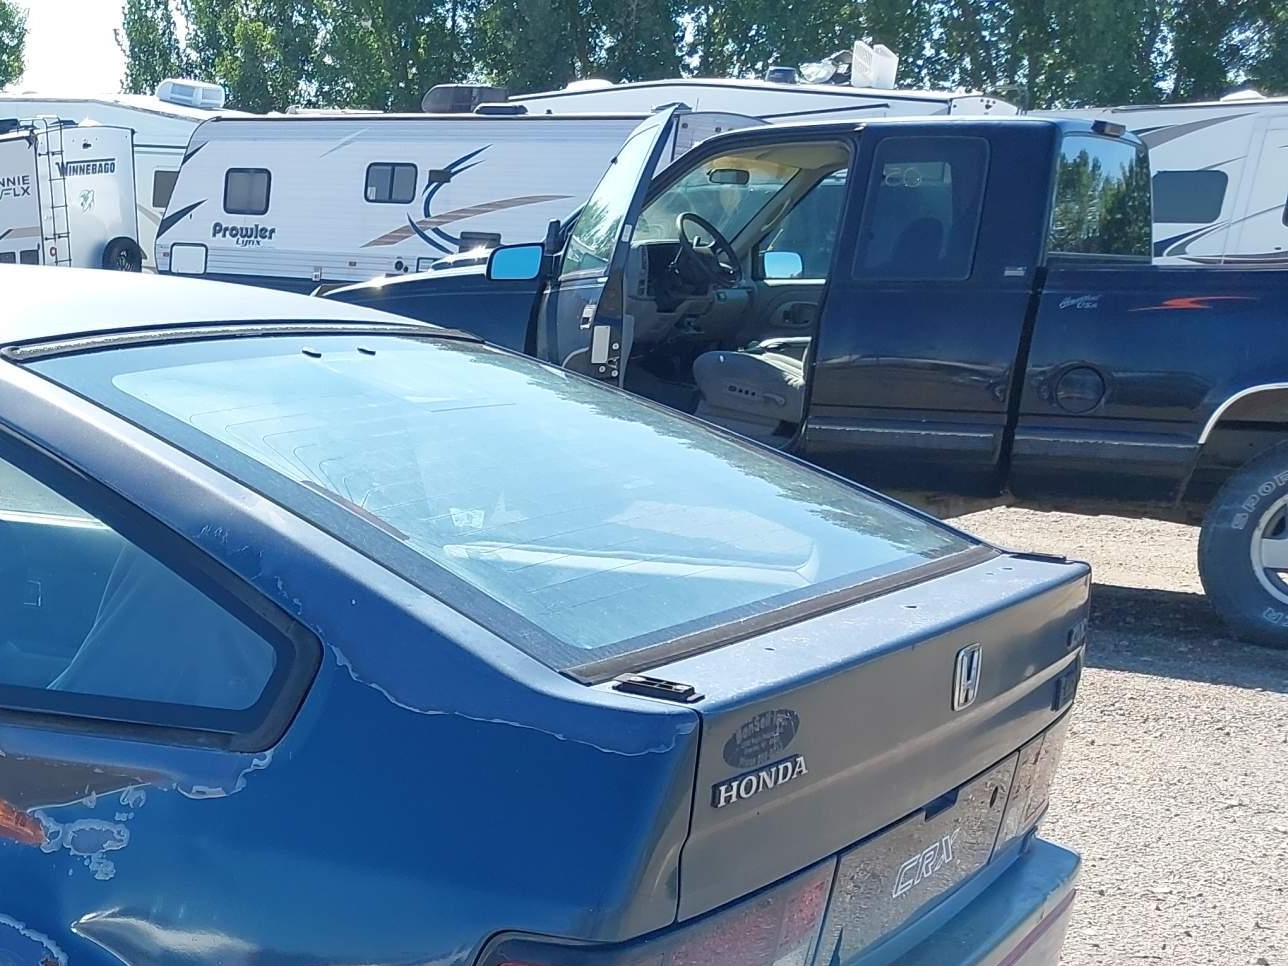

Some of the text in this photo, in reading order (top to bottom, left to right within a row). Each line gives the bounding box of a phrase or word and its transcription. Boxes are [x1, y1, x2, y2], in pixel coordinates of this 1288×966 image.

[55, 158, 116, 177] WINNEBAGO
[211, 221, 276, 240] Prowler
[235, 237, 262, 248] Lynx
[717, 756, 808, 808] HONDA
[892, 827, 961, 898] CRX
